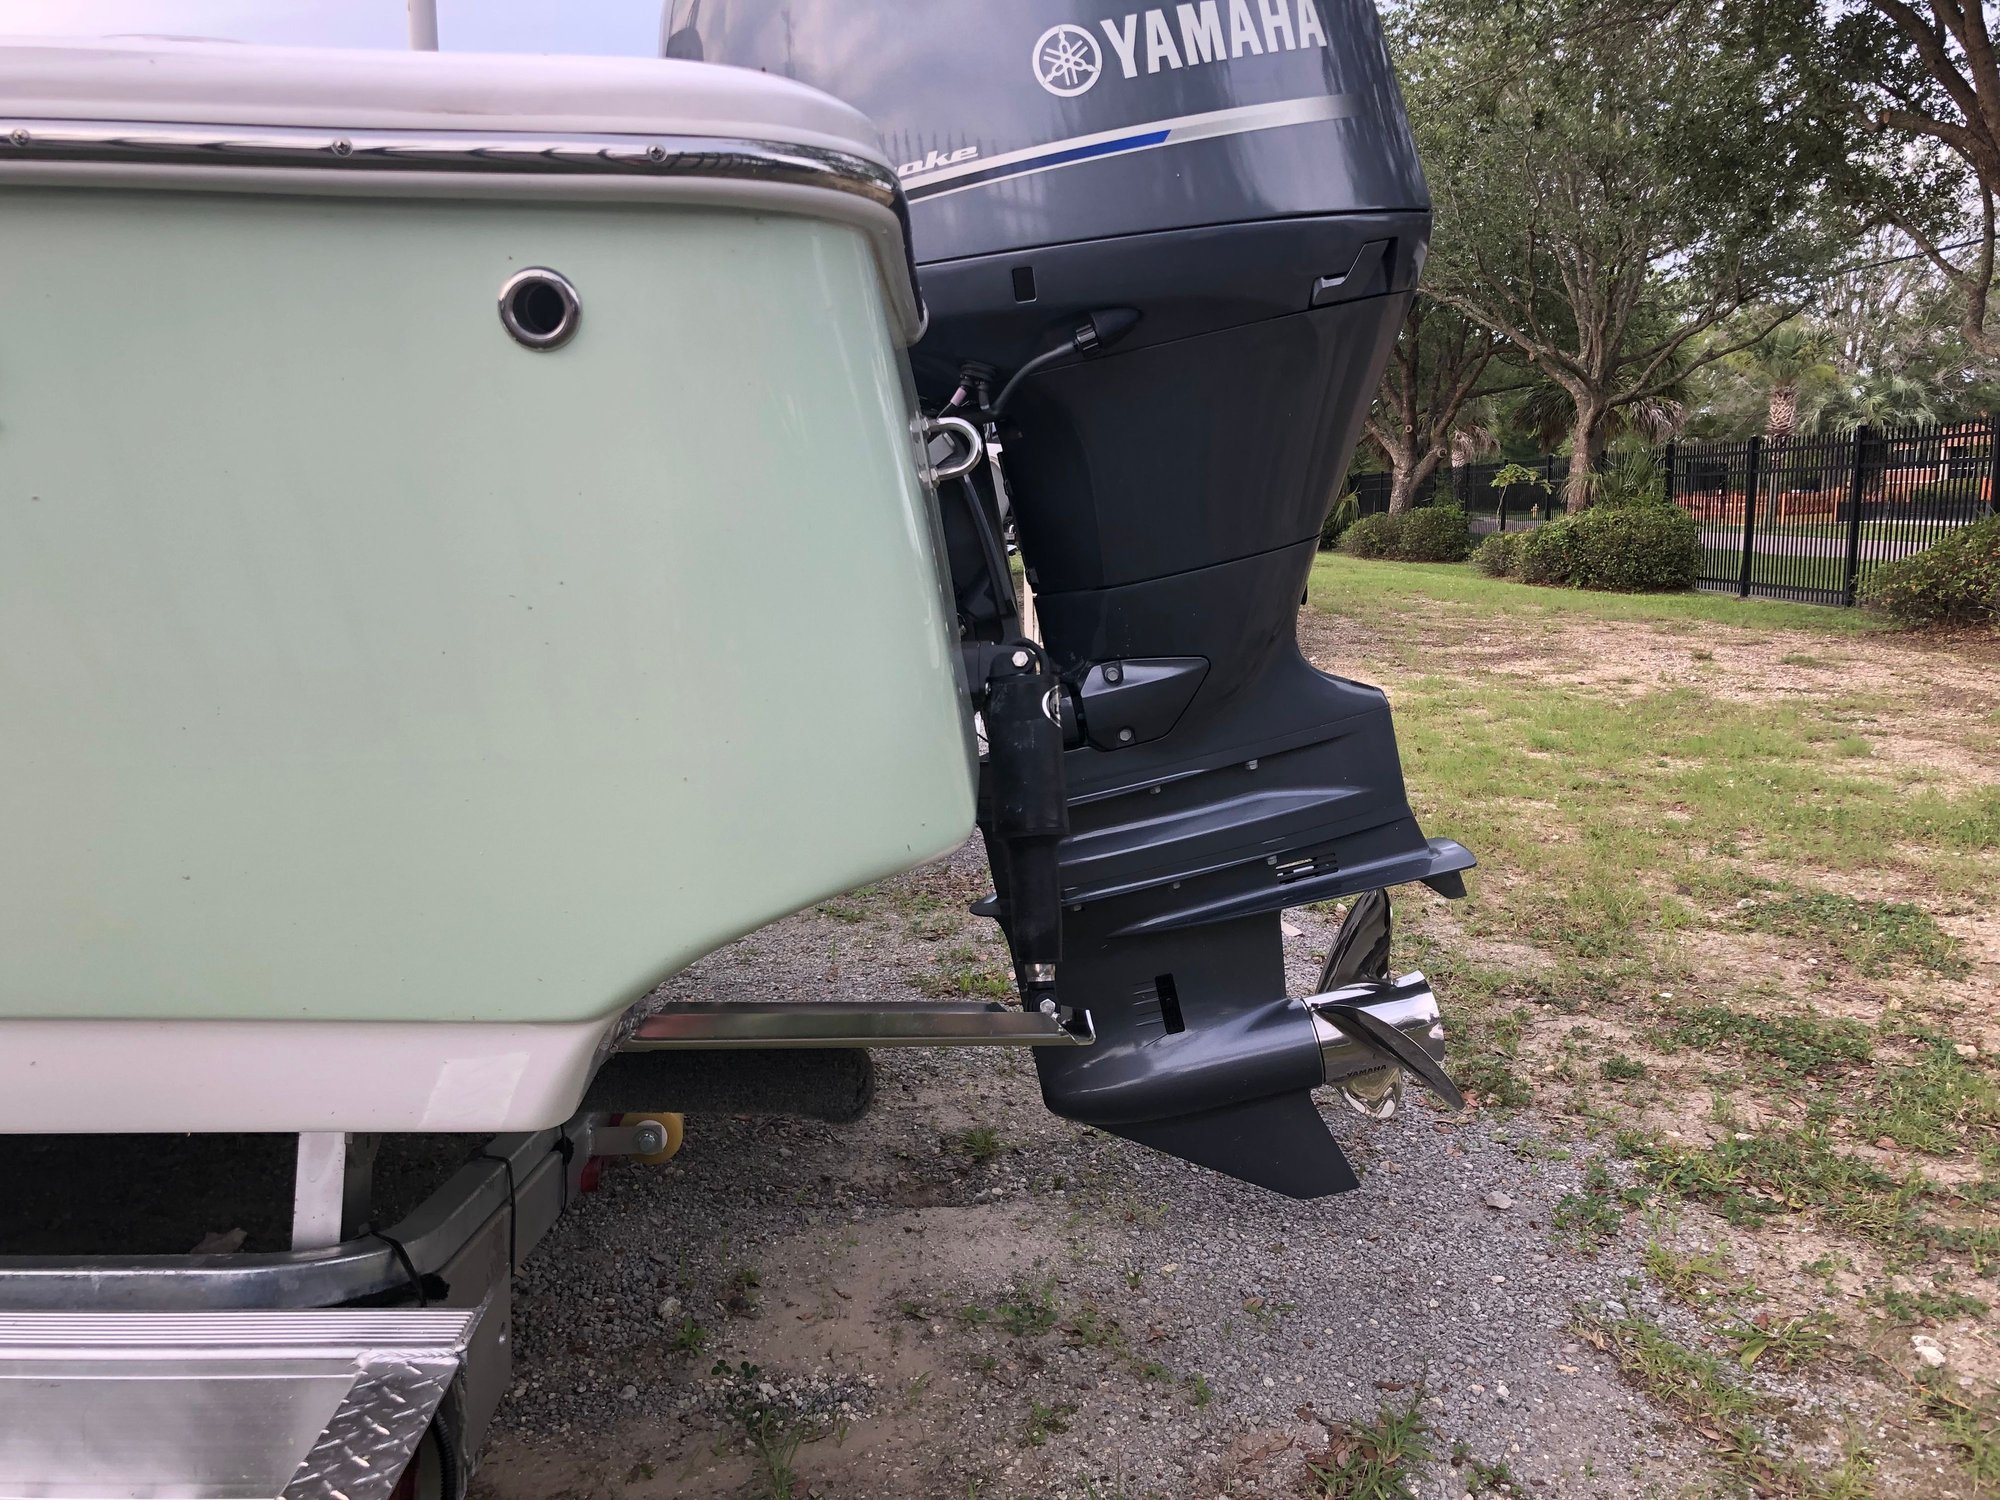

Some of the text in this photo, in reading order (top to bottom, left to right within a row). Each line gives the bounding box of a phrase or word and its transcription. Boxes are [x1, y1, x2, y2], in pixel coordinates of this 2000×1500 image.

[1100, 0, 1328, 79] YAMAHA
[894, 146, 979, 177] oke
[1346, 1064, 1387, 1077] YAMAHA
